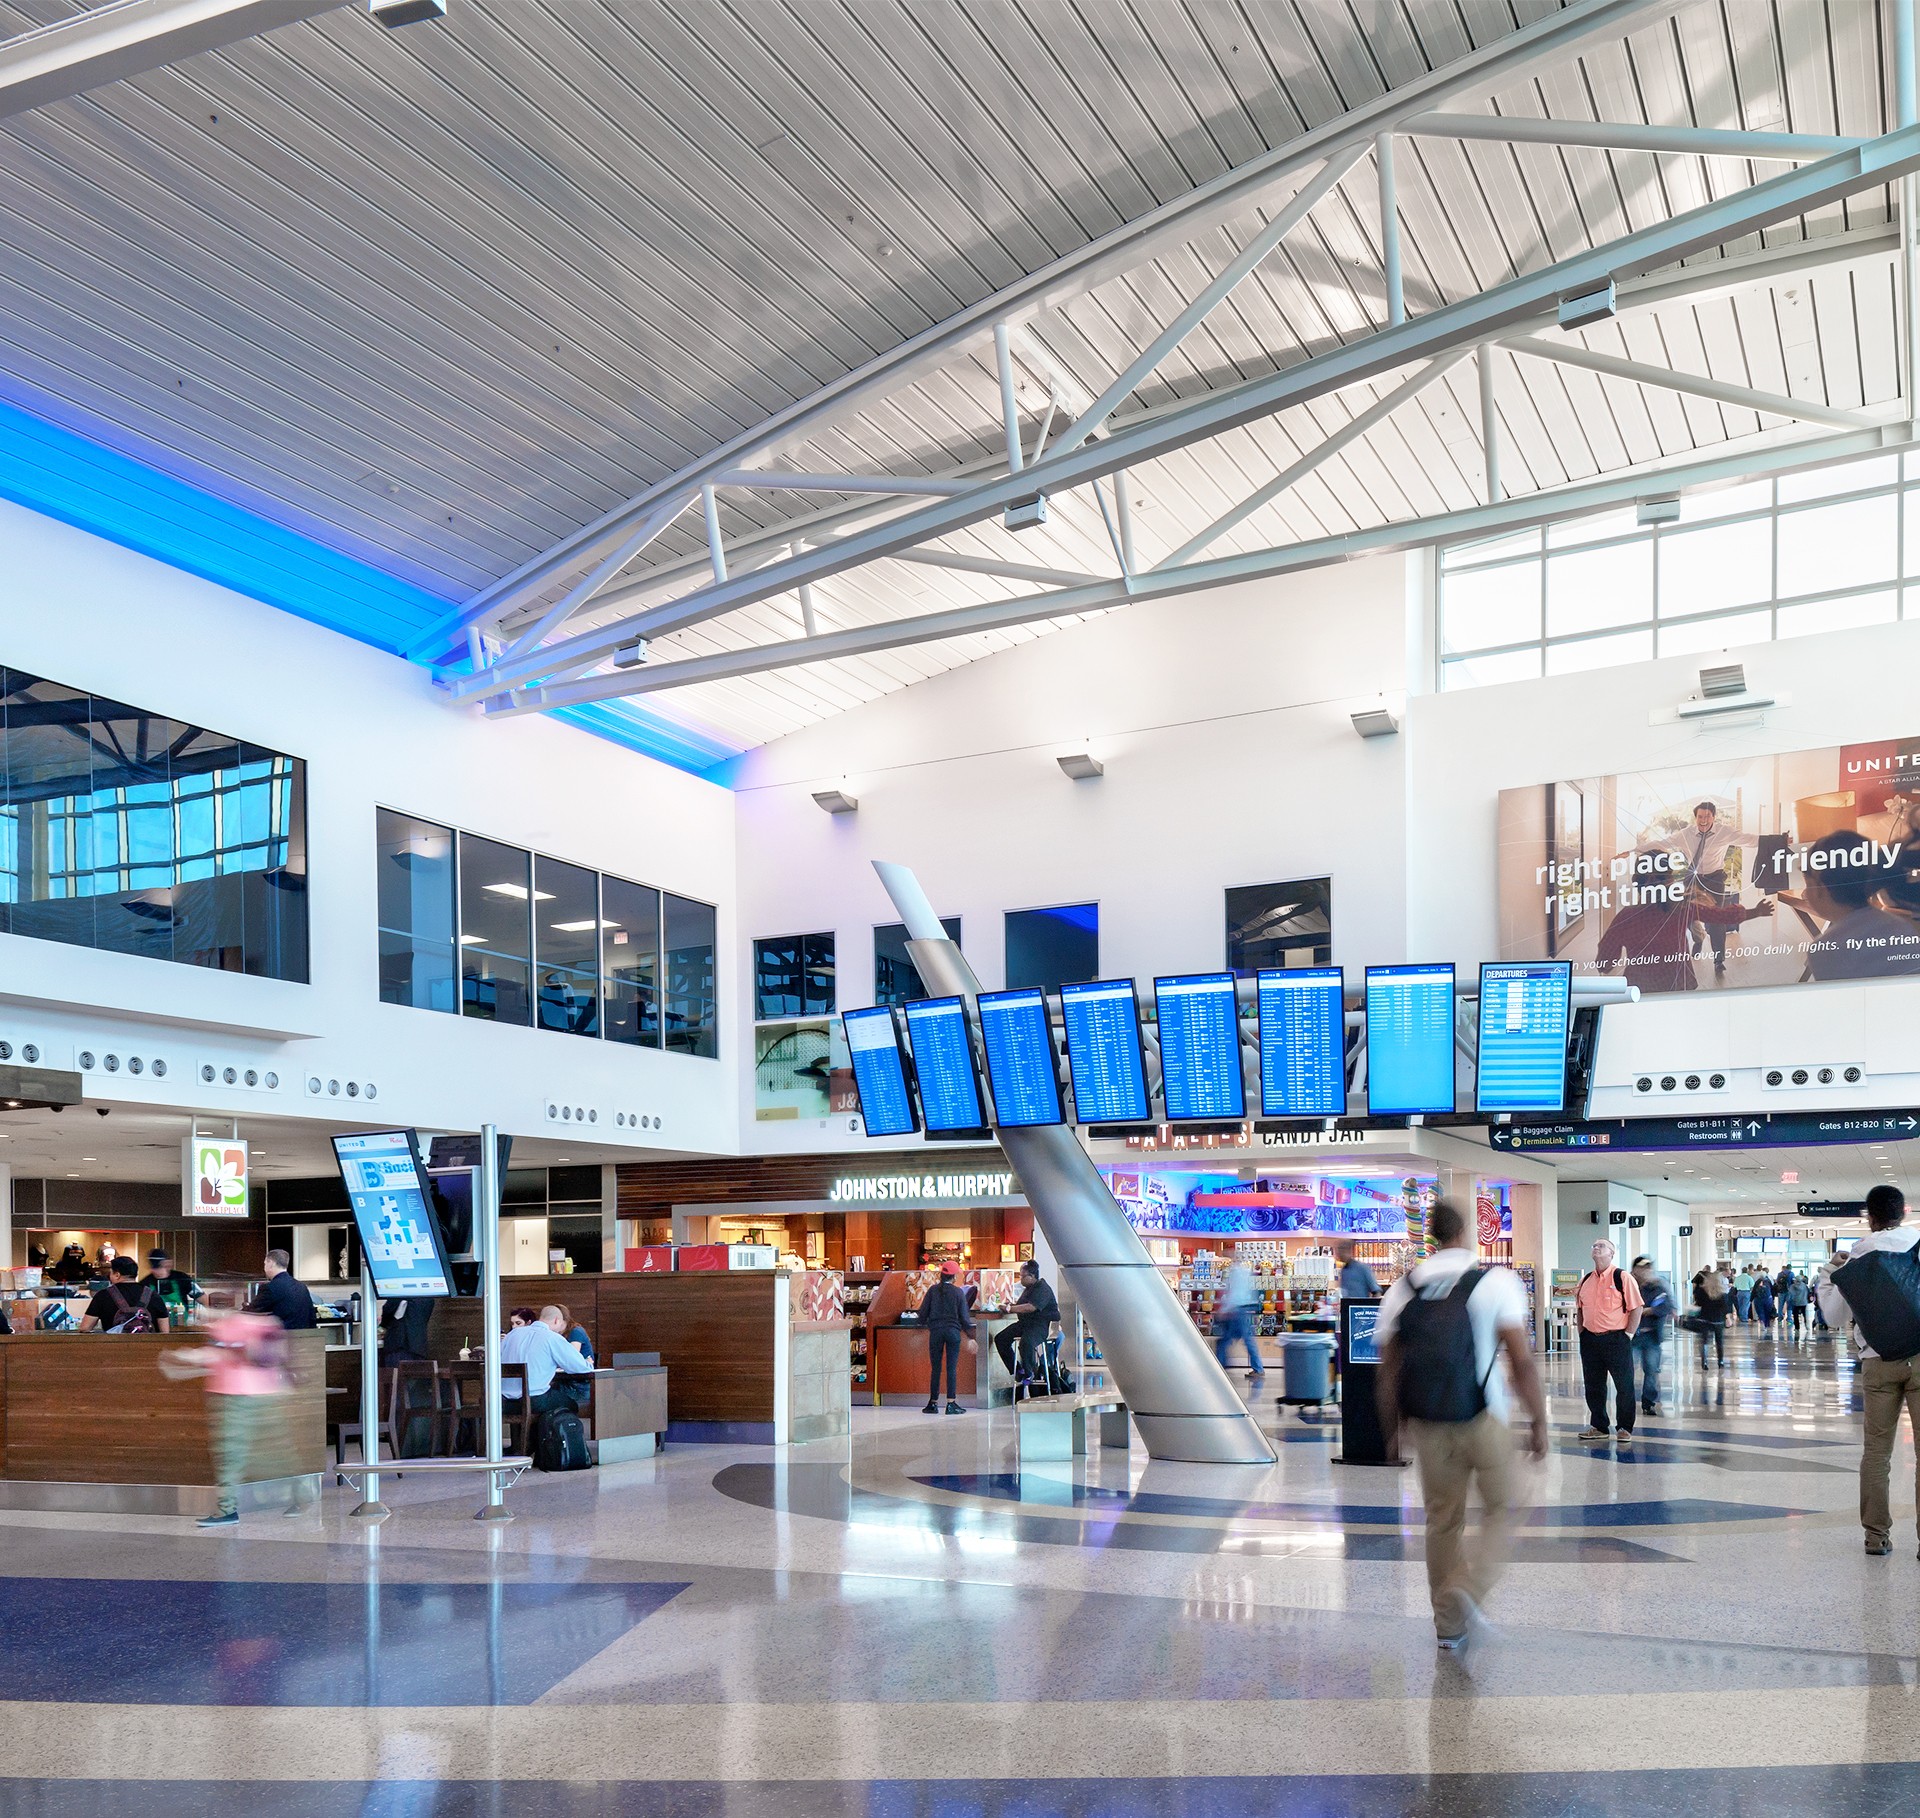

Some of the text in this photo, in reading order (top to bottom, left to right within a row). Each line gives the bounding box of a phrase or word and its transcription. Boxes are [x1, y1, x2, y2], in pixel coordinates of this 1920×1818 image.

[1771, 839, 1902, 874] friendly
[1535, 850, 1685, 886] right place
[1544, 881, 1685, 917] right time
[1583, 958, 1608, 971] your
[1611, 953, 1660, 968] schedule
[1663, 951, 1690, 963] with
[1693, 949, 1720, 961] over
[1724, 946, 1759, 960] 5,000
[1763, 943, 1793, 956] daily
[1797, 940, 1840, 954] flights.
[1845, 938, 1863, 950] fly
[1866, 937, 1887, 948] the
[1485, 969, 1528, 979] DEPARTURES
[1677, 1120, 1726, 1129] Gates B1-B11
[1819, 1120, 1879, 1130] Gates B12-B20
[1523, 1125, 1574, 1136] Baggage Claim
[1569, 1136, 1576, 1145] A
[1602, 1135, 1607, 1143] E
[1689, 1132, 1728, 1140] Restrooms
[830, 1173, 1013, 1201] JOHNSTON & MURPHY
[1356, 1186, 1374, 1198] PEZ
[357, 1197, 366, 1207] B
[195, 1205, 245, 1215] MARKETPLACE
